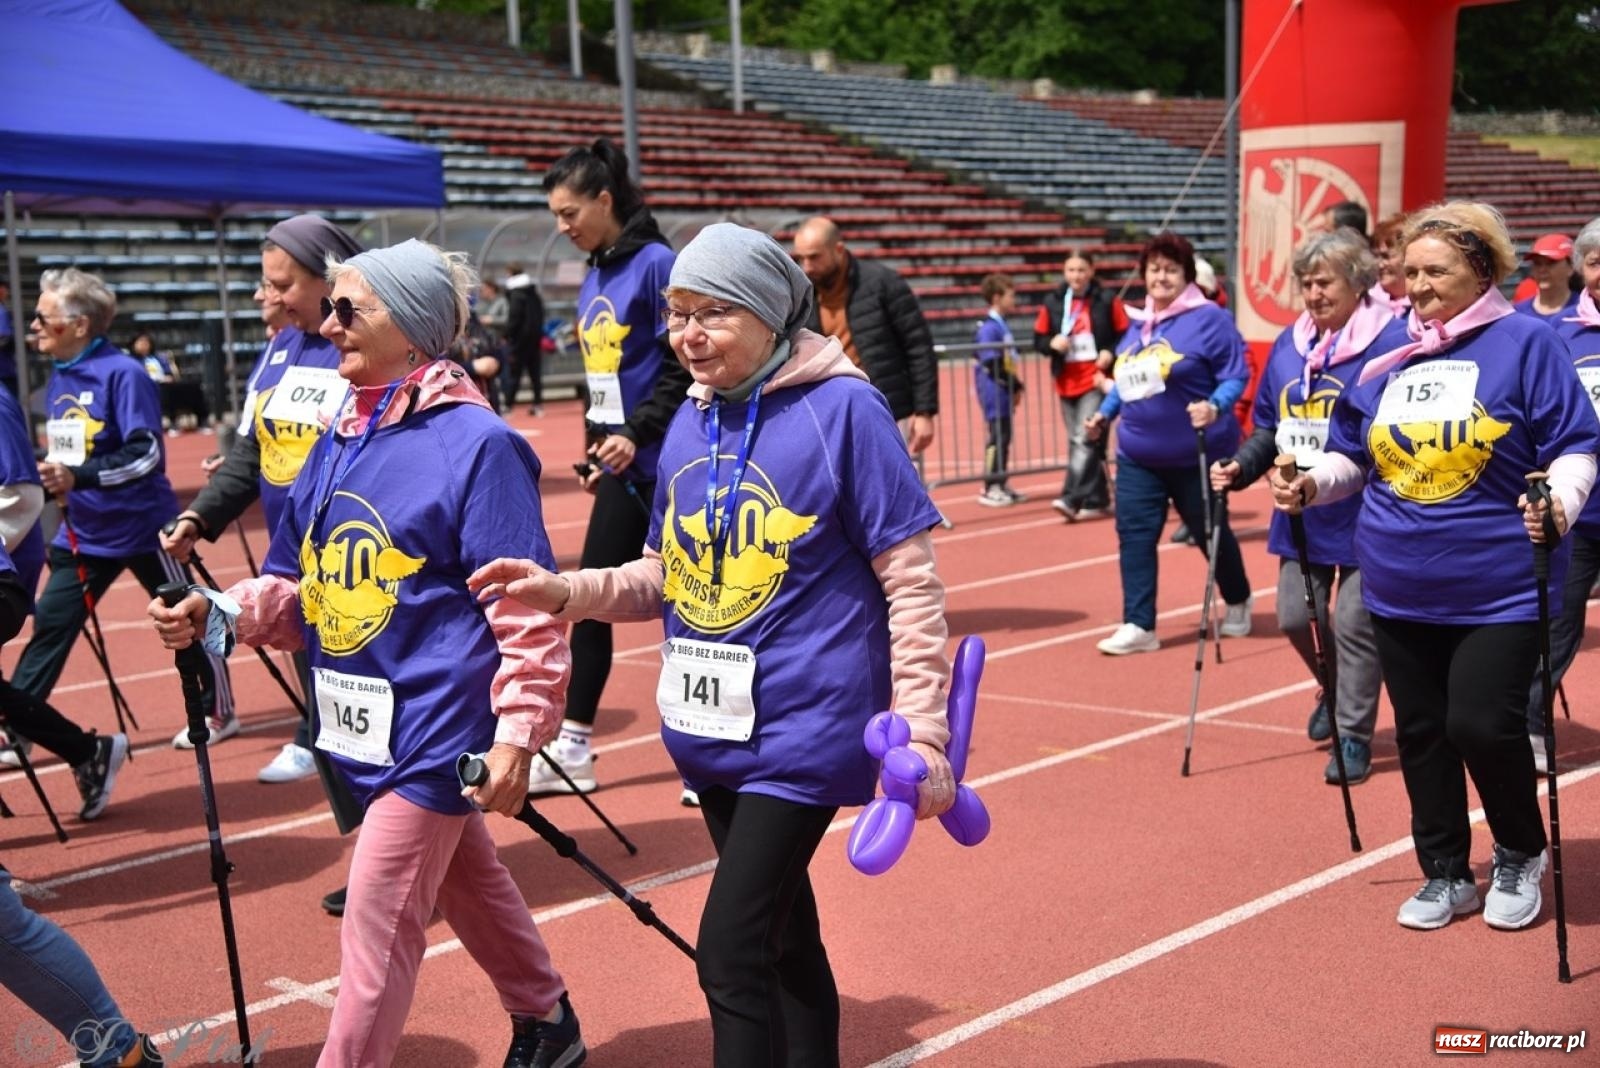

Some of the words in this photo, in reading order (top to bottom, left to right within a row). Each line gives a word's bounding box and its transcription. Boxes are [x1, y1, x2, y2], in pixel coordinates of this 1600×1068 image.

[290, 385, 327, 406] 074
[663, 539, 722, 604] RACIORSI
[720, 596, 753, 622] BARIER
[677, 644, 694, 656] BIEG
[695, 647, 711, 659] BEZ
[713, 649, 749, 663] BARIER
[340, 679, 355, 691] BEZ
[357, 682, 388, 694] BARIER
[683, 672, 720, 708] 141
[334, 700, 370, 735] 145
